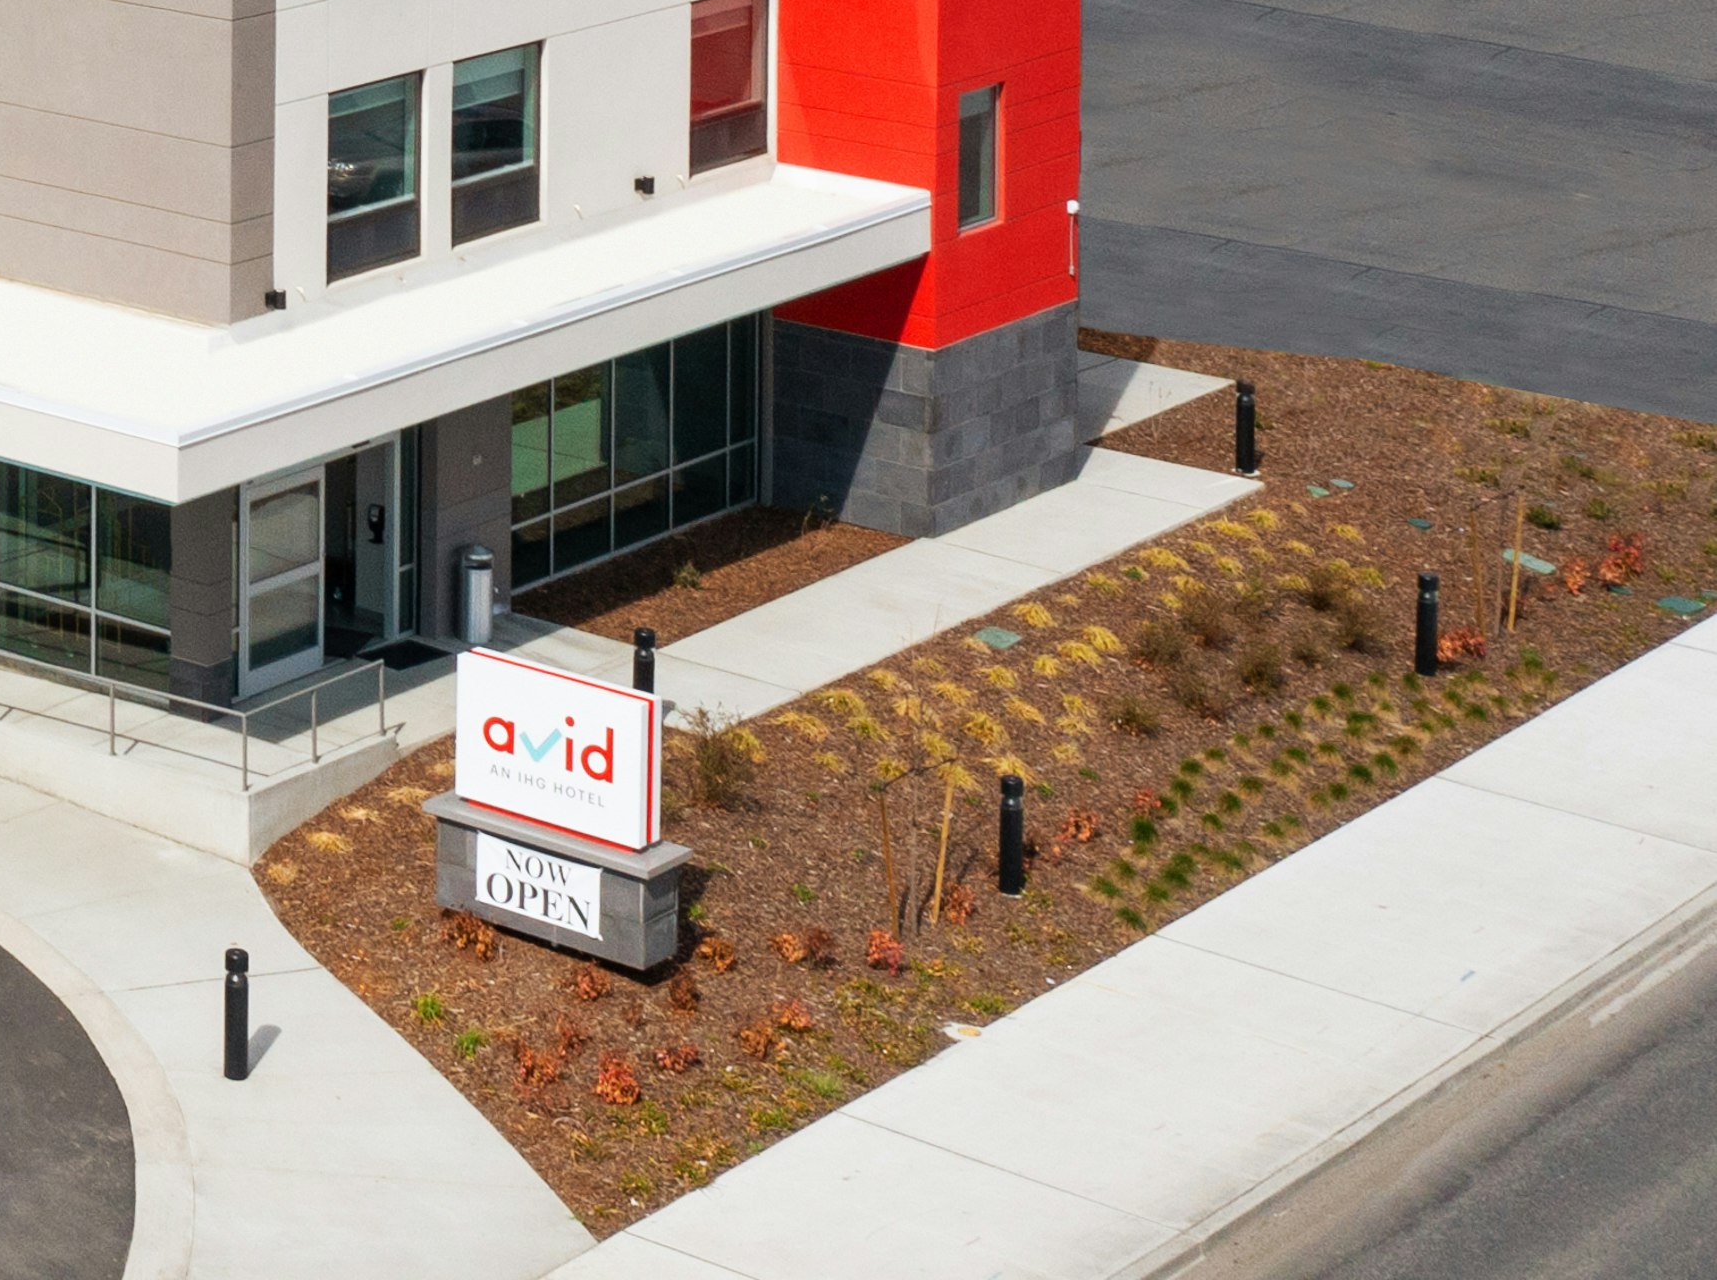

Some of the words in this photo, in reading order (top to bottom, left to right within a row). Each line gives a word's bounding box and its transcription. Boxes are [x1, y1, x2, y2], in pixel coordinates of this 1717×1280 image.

[482, 715, 614, 784] avid
[489, 763, 511, 779] AN
[518, 771, 547, 790] IHG
[553, 781, 605, 808] HOTEL
[505, 848, 572, 886] NOW
[486, 872, 591, 931] OPEN
